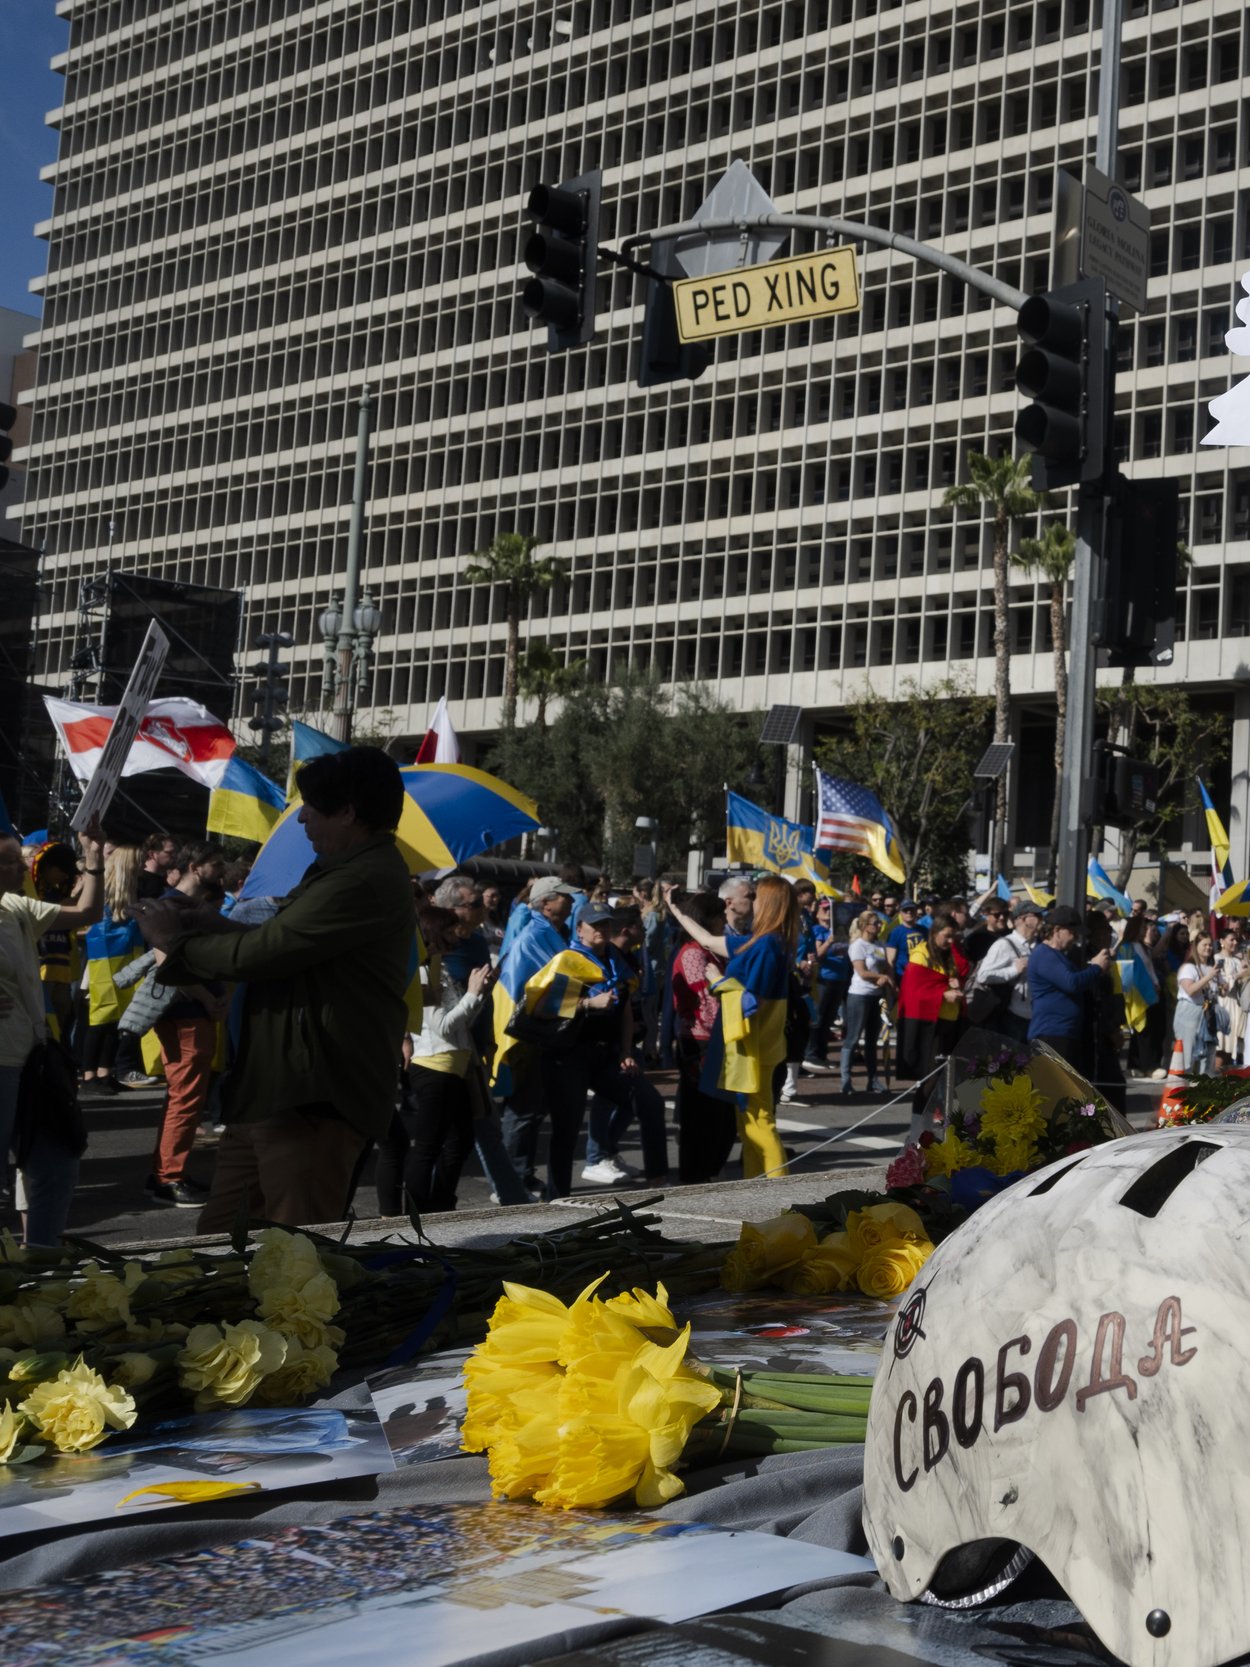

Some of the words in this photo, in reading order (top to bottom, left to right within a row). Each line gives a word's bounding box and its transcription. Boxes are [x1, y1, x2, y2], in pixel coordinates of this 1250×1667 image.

[691, 281, 751, 325] PED
[764, 262, 840, 312] XING
[893, 1295, 1198, 1492] СВОБОДА
